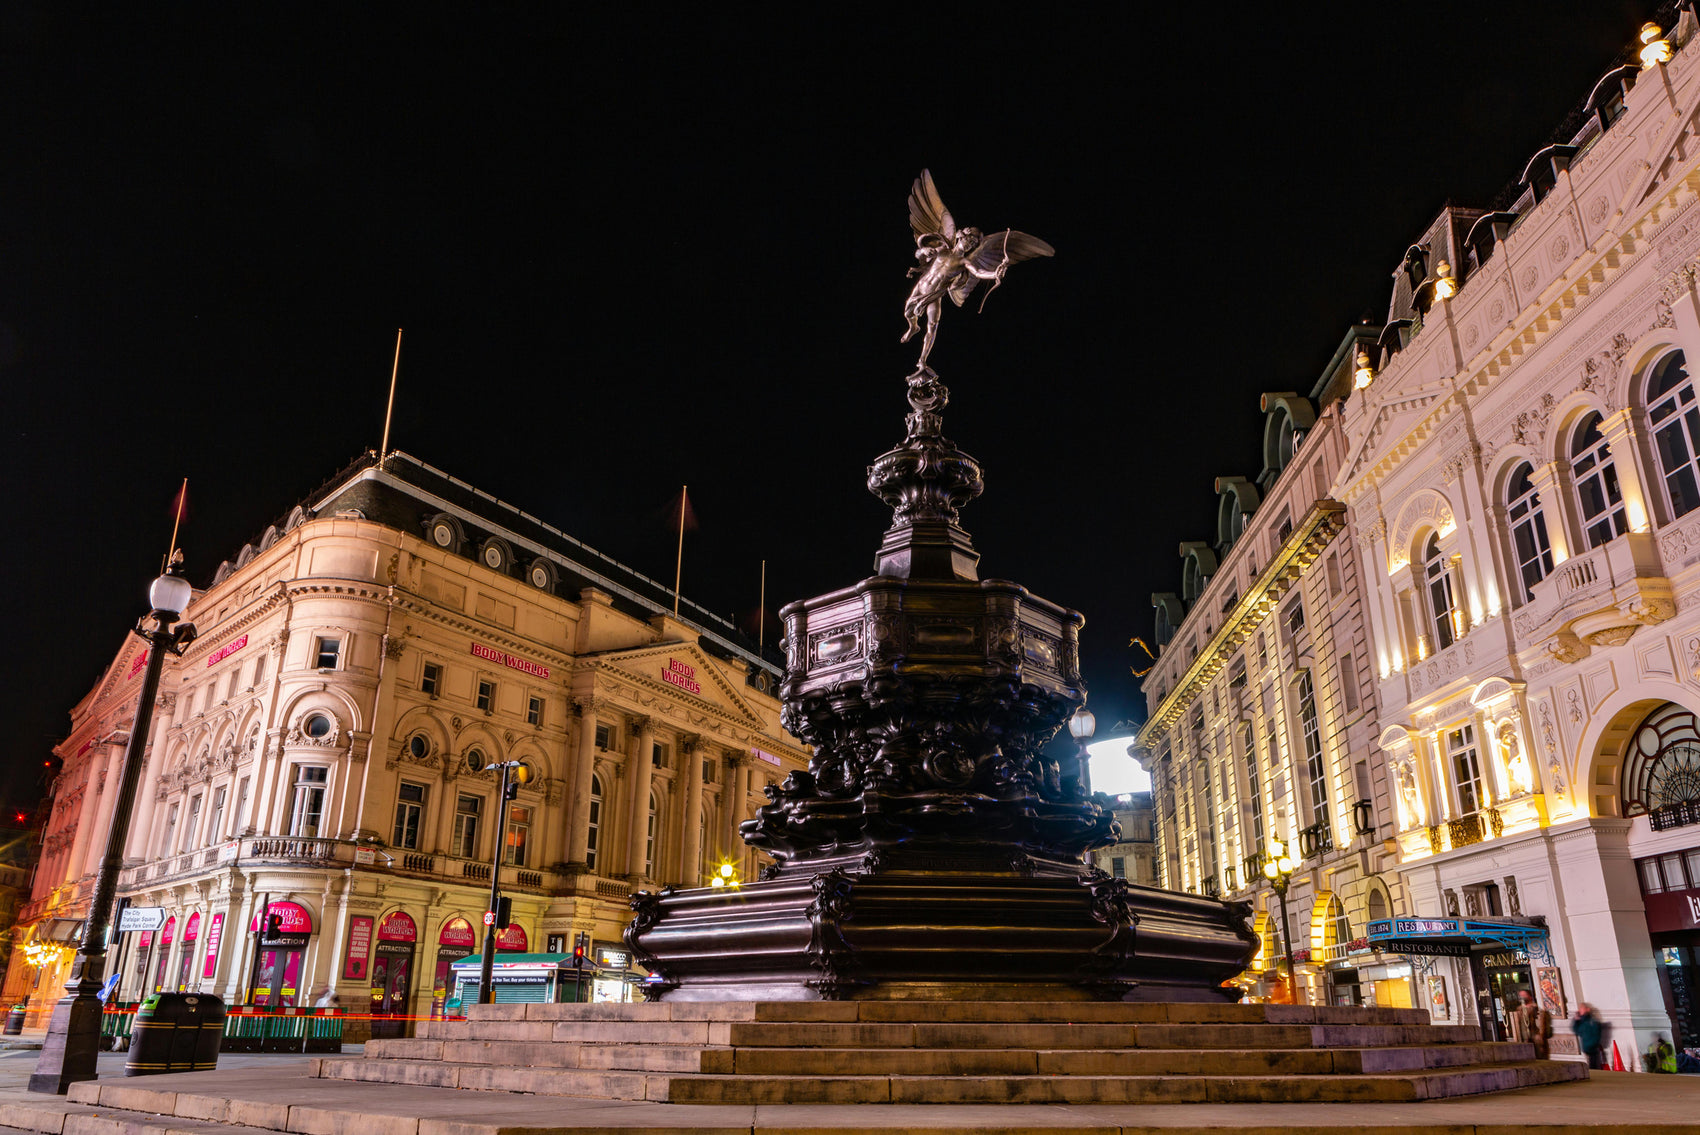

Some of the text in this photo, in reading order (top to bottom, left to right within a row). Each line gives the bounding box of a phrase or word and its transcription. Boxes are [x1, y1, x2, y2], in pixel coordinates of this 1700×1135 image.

[472, 643, 551, 680] BODY WORLDS
[670, 658, 697, 680] BODY
[662, 668, 701, 695] WORLDS
[388, 919, 409, 928] BODY
[1398, 922, 1456, 932] RESTAURANT
[382, 925, 413, 936] WORLDS
[444, 931, 472, 940] WORLDS
[440, 949, 470, 957] ATTRACTION
[1391, 942, 1469, 954] RISTORANTE
